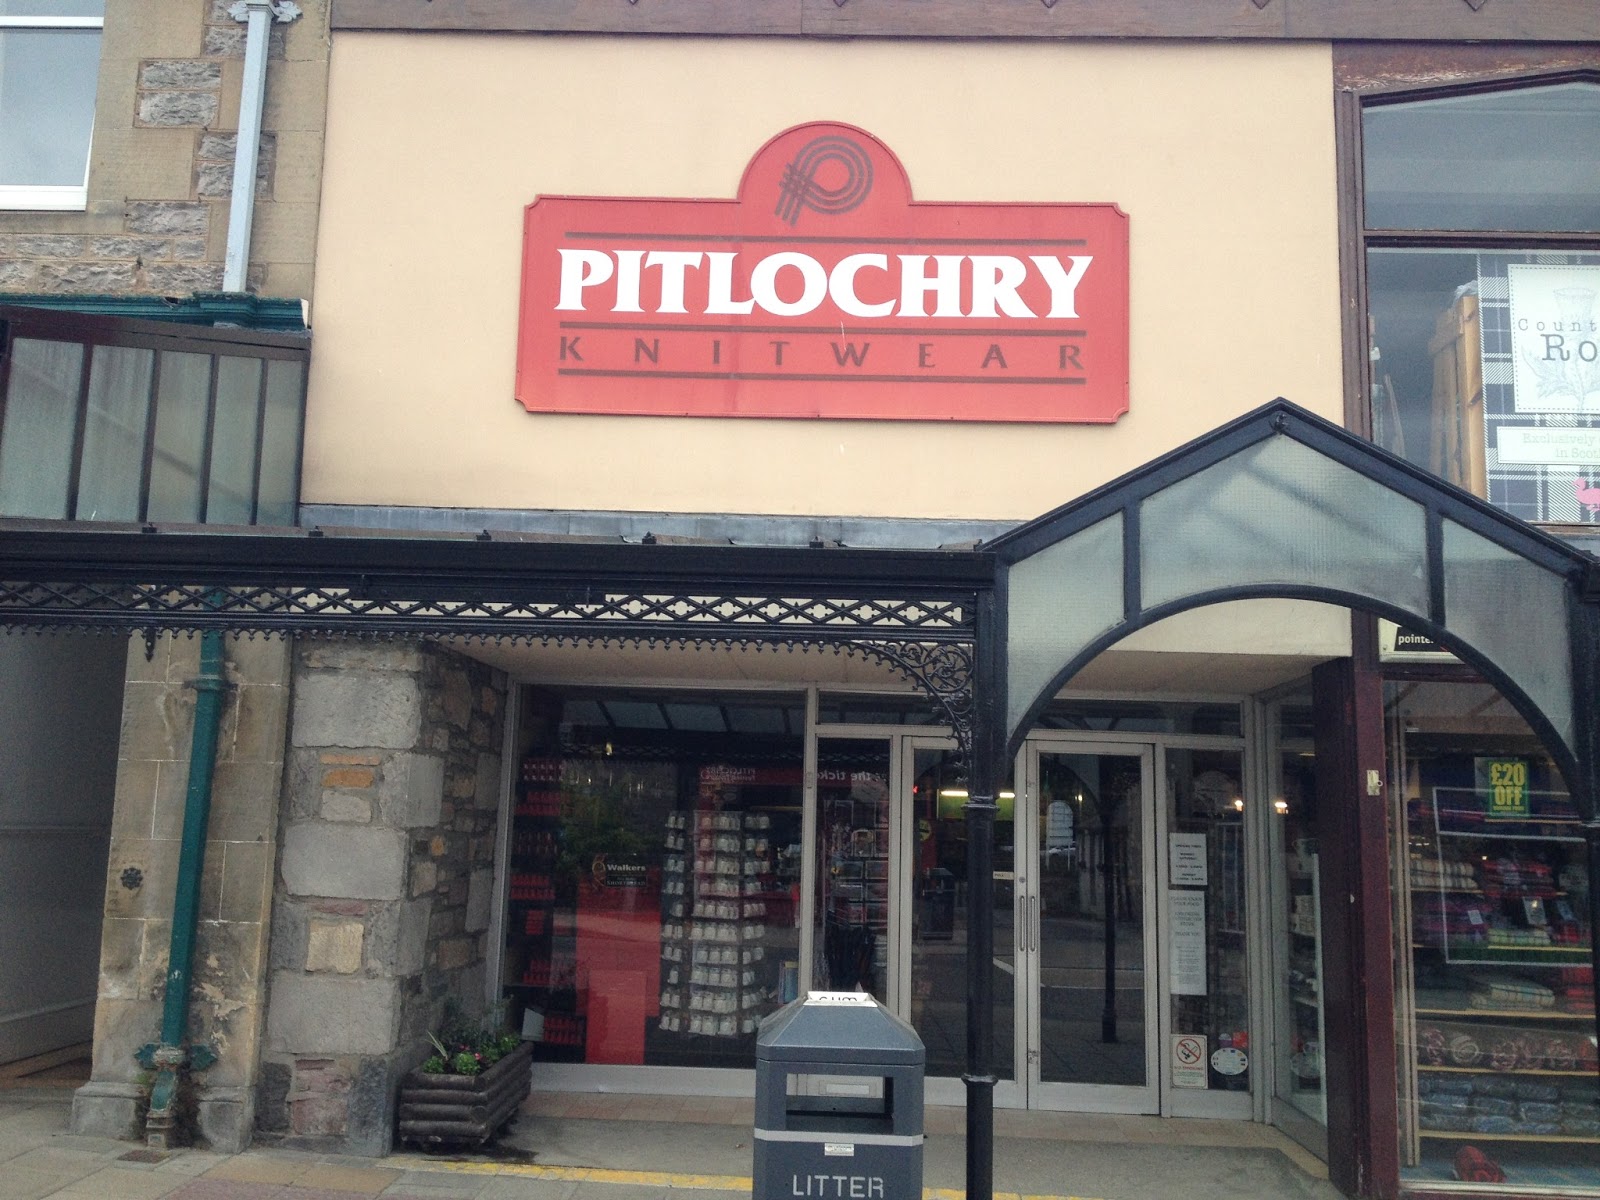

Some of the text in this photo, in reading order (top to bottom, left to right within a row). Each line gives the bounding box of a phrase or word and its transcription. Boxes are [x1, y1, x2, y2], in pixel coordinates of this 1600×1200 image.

[554, 248, 1094, 319] PITLOCHRY
[1518, 318, 1598, 332] Count
[559, 336, 1084, 370] KNITWEAR
[1540, 333, 1599, 362] Ro
[1522, 432, 1596, 447] Exclusively
[1398, 634, 1434, 646] pointe
[1491, 763, 1525, 786] £20
[1494, 785, 1523, 805] OFF
[607, 864, 646, 872] Walkers
[792, 1174, 884, 1200] LITTER
